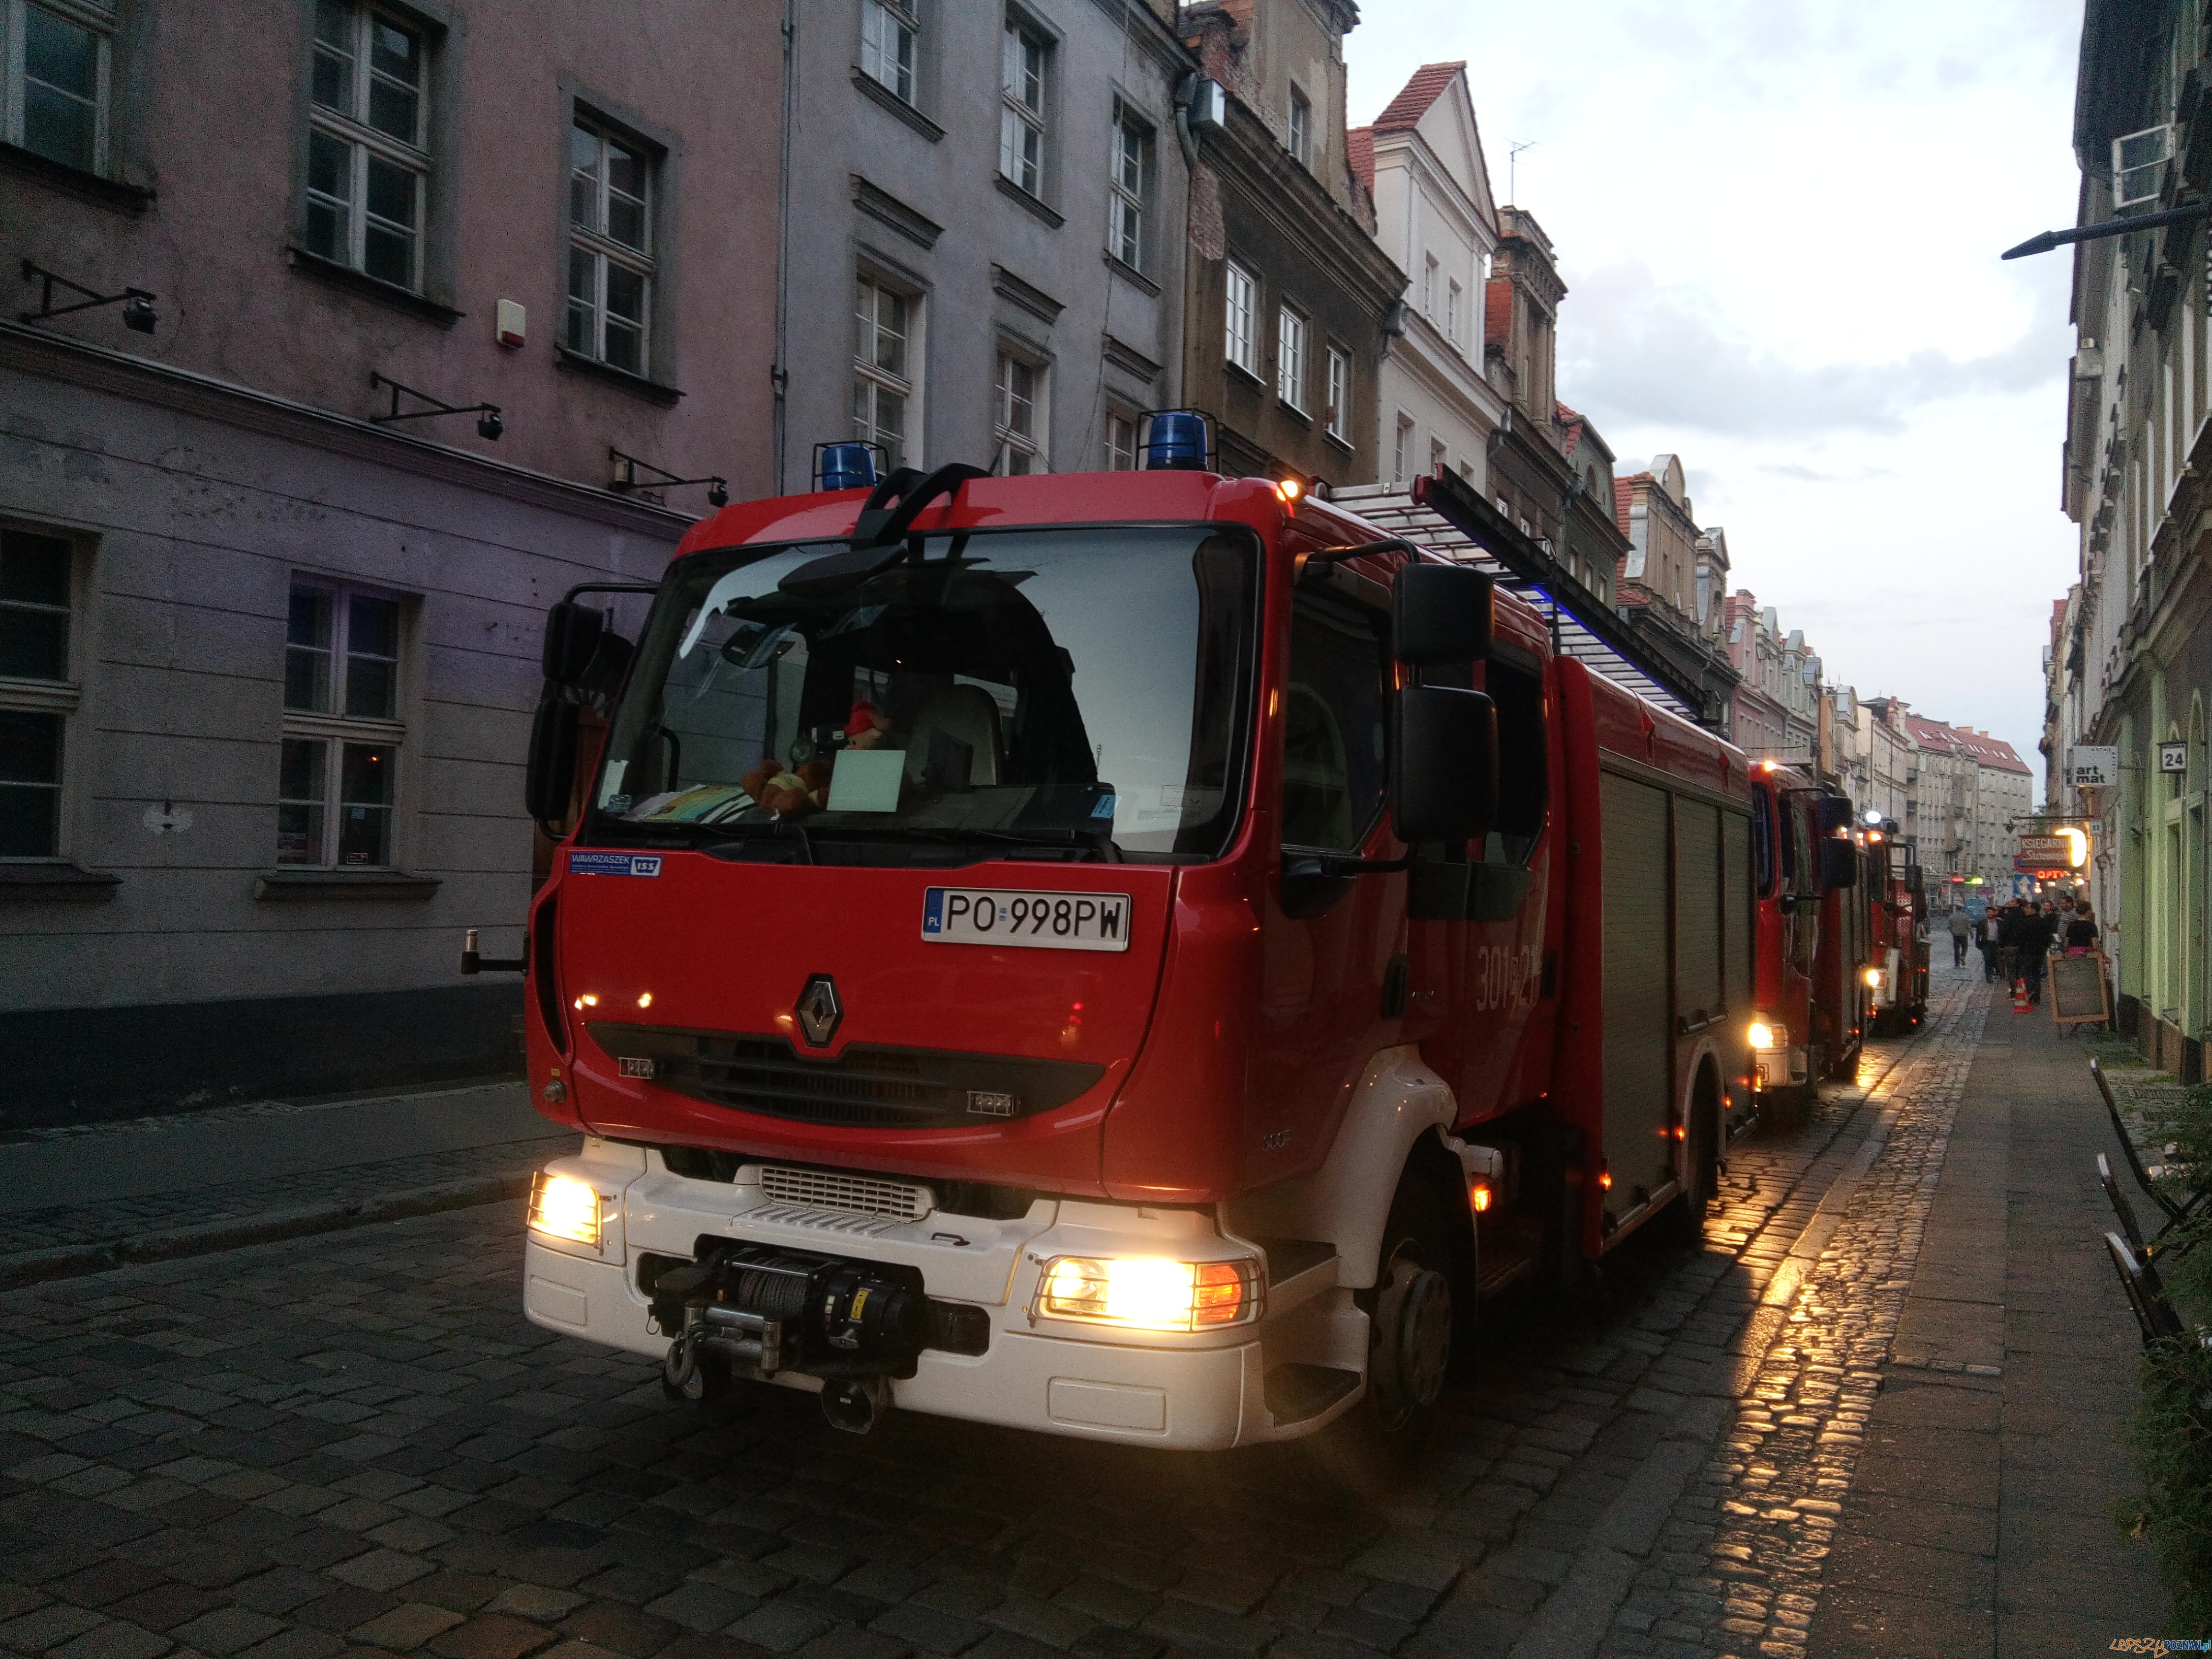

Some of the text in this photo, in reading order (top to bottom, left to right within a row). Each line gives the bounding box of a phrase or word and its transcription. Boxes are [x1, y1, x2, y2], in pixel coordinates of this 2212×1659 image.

[2165, 753, 2184, 766] 24
[2077, 765, 2098, 775] art
[2077, 774, 2105, 783] mat
[572, 854, 631, 864] WAWRZASZEK
[637, 862, 655, 871] ISS
[947, 895, 1122, 938] PO 998PW
[928, 917, 940, 927] PL
